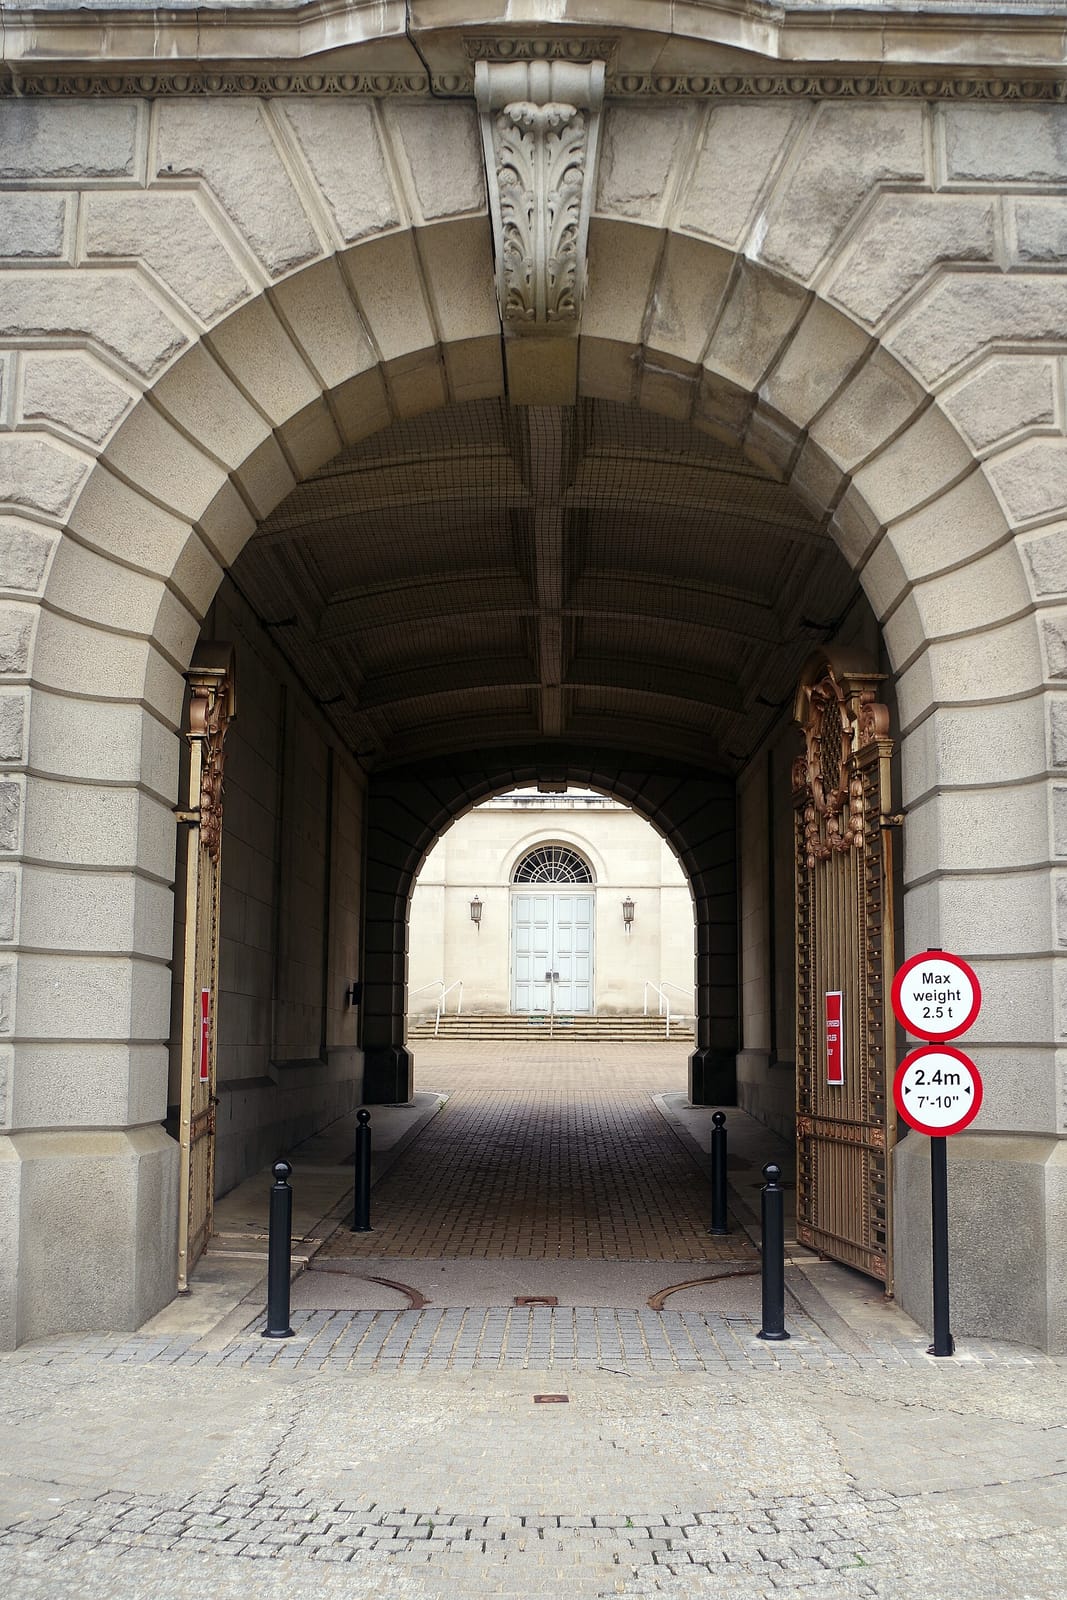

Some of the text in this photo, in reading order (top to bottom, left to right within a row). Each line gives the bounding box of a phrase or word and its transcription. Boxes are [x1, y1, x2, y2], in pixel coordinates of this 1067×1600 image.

[922, 972, 951, 984] Max
[913, 989, 961, 1004] weight
[922, 1006, 953, 1019] 2.5 t
[914, 1069, 961, 1086] 2.4m
[917, 1095, 959, 1109] 7'-10"
